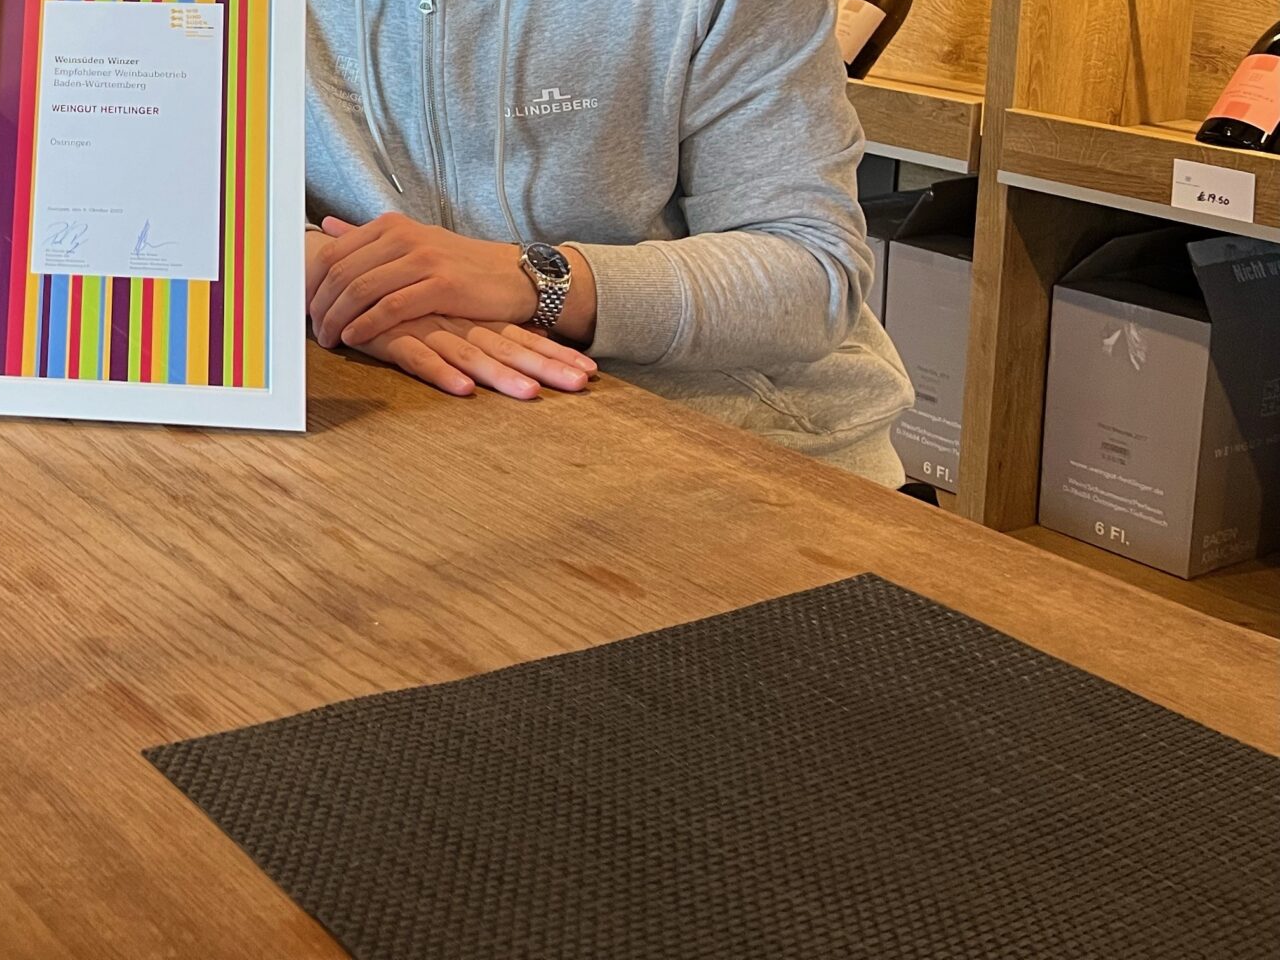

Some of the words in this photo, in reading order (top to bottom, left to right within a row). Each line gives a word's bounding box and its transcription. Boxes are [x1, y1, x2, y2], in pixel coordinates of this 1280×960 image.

[54, 55, 105, 65] Weinsüden
[107, 57, 140, 66] Winzer
[54, 67, 112, 78] Empfohlener
[114, 69, 187, 80] Weinbaubetrieb
[53, 79, 147, 91] Baden-Württemberg
[51, 104, 97, 113] WEINGUT
[100, 106, 159, 115] HEITLINGER
[504, 98, 598, 118] J.LINDEBERG
[923, 461, 932, 474] 6
[936, 465, 954, 483] Fl.
[1095, 521, 1105, 536] 6
[1110, 526, 1130, 546] Fl.
